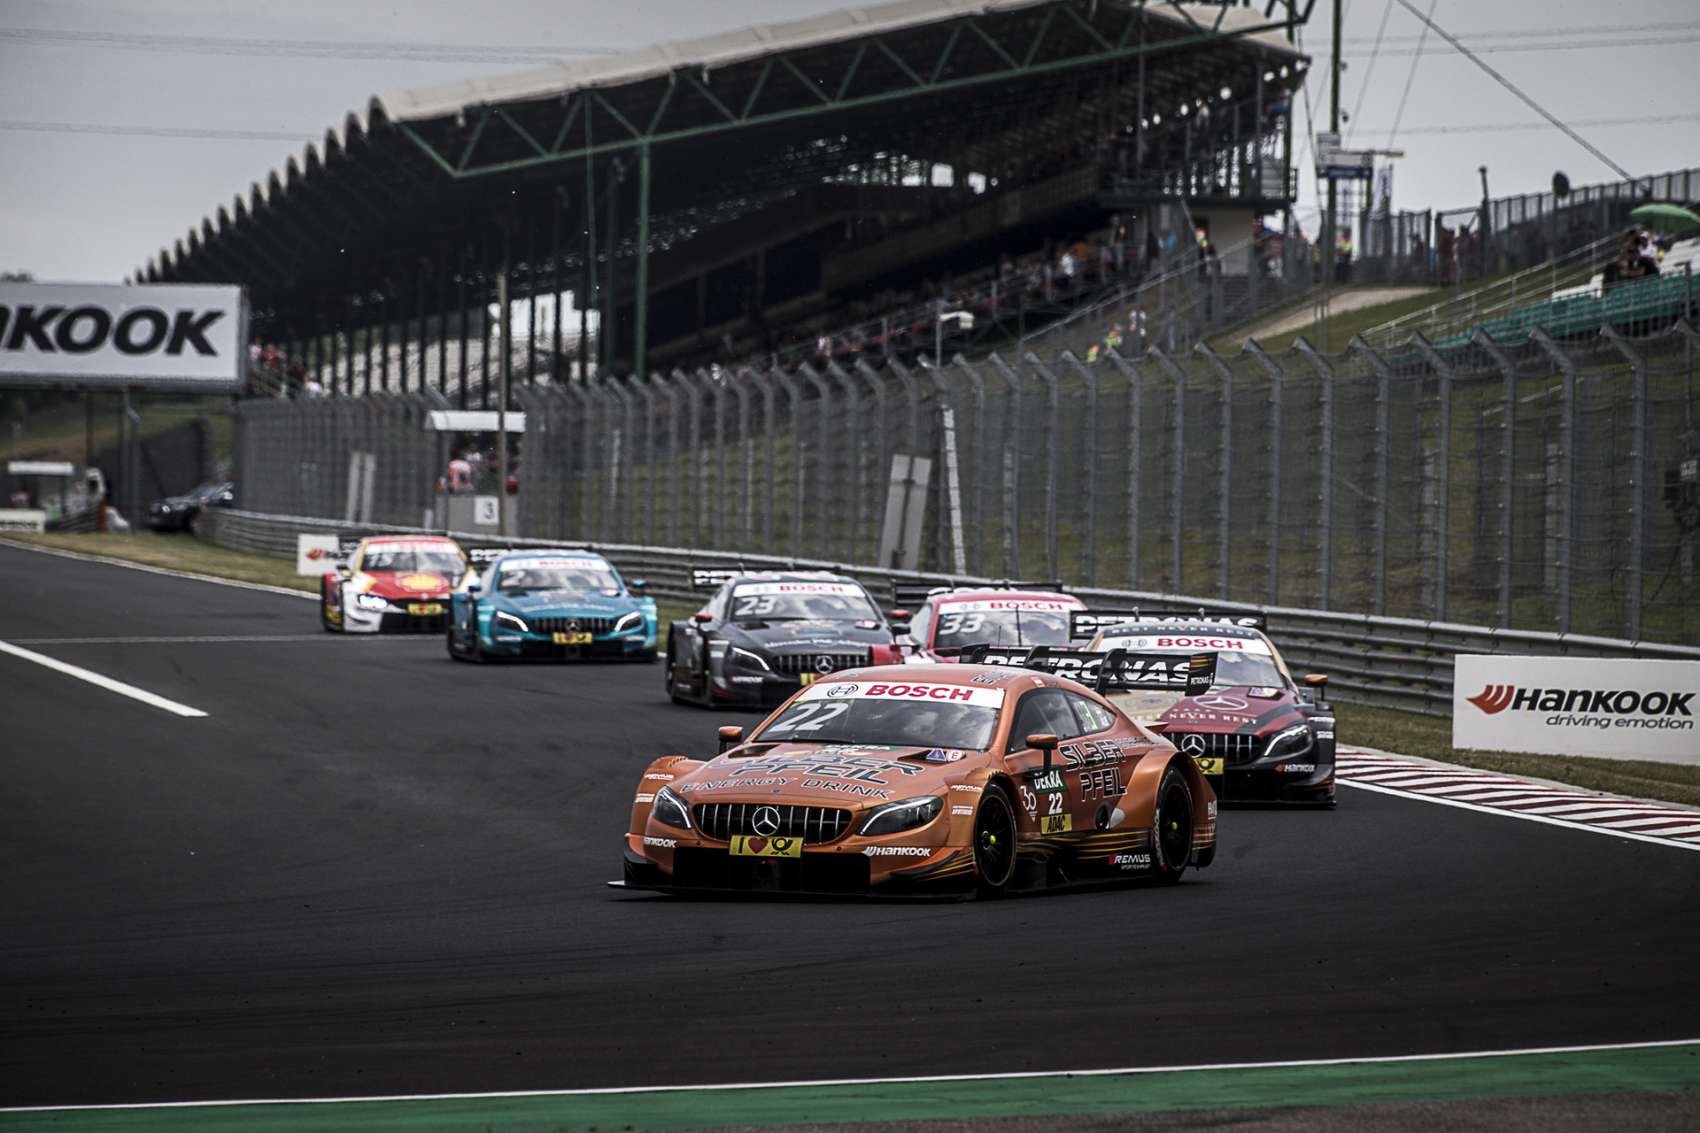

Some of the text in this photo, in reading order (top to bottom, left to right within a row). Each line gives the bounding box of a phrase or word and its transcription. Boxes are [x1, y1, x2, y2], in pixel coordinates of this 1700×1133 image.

[0, 304, 226, 357] KOOK
[735, 598, 777, 616] 23
[990, 602, 1053, 610] BOSCH
[939, 614, 986, 635] 33
[1157, 638, 1244, 650] BOSCH
[865, 685, 973, 701] BOSCH
[768, 703, 849, 734] 22
[1169, 711, 1216, 720] NEVER
[1546, 714, 1694, 730] driving emotion
[1059, 740, 1126, 773] SILBER
[729, 763, 889, 785] PFEIL
[1034, 769, 1064, 789] DEKRA
[679, 777, 895, 801] ENERGY DRINK
[1080, 767, 1128, 802] PFEIL
[1048, 792, 1063, 815] 22
[1114, 854, 1151, 864] REMUS
